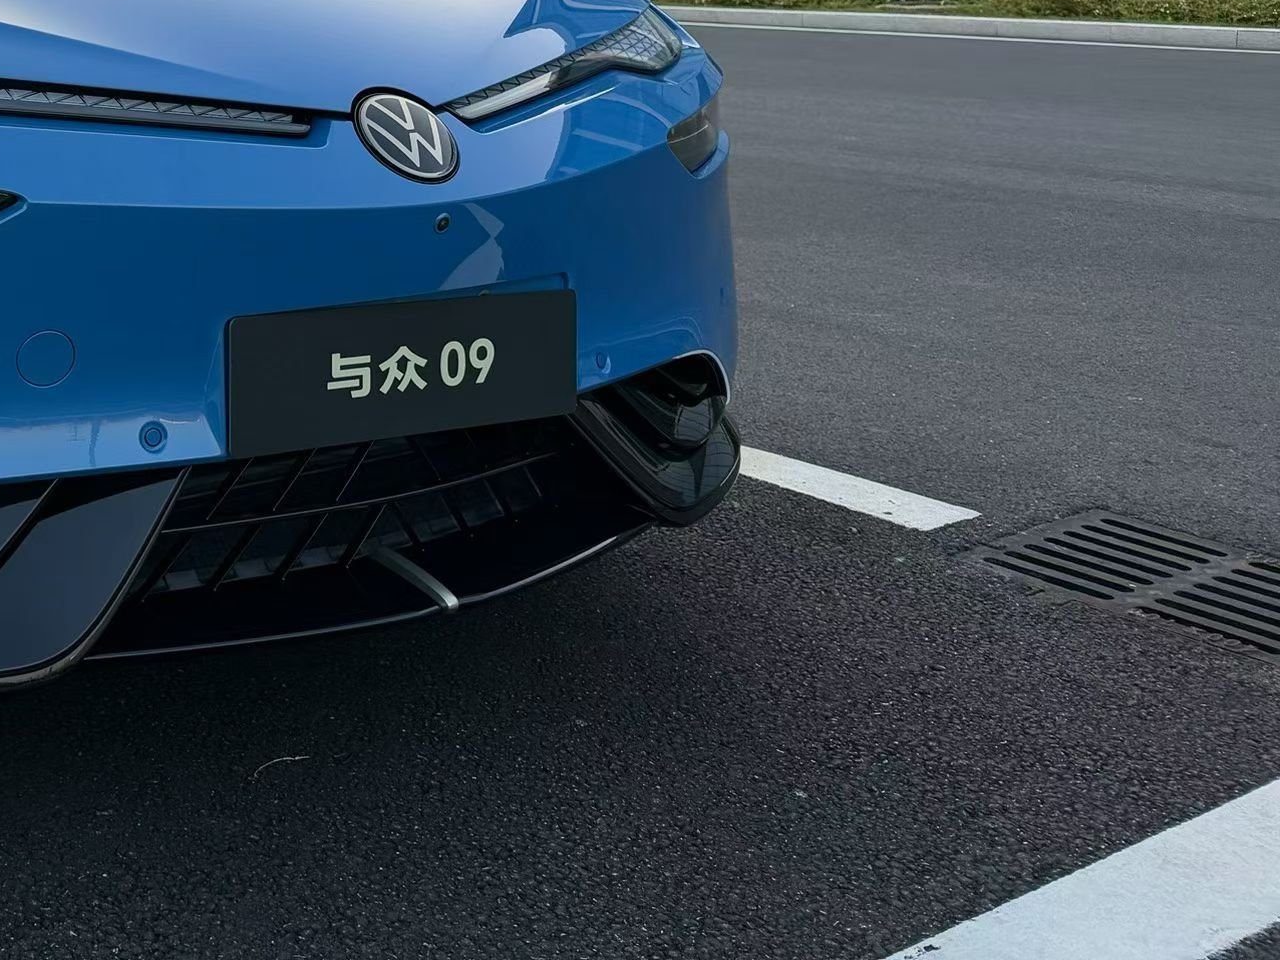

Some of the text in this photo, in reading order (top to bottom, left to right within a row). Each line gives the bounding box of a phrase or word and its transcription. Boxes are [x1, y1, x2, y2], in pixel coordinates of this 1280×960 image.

[360, 94, 454, 178] VW
[327, 337, 496, 399] 与众 09
